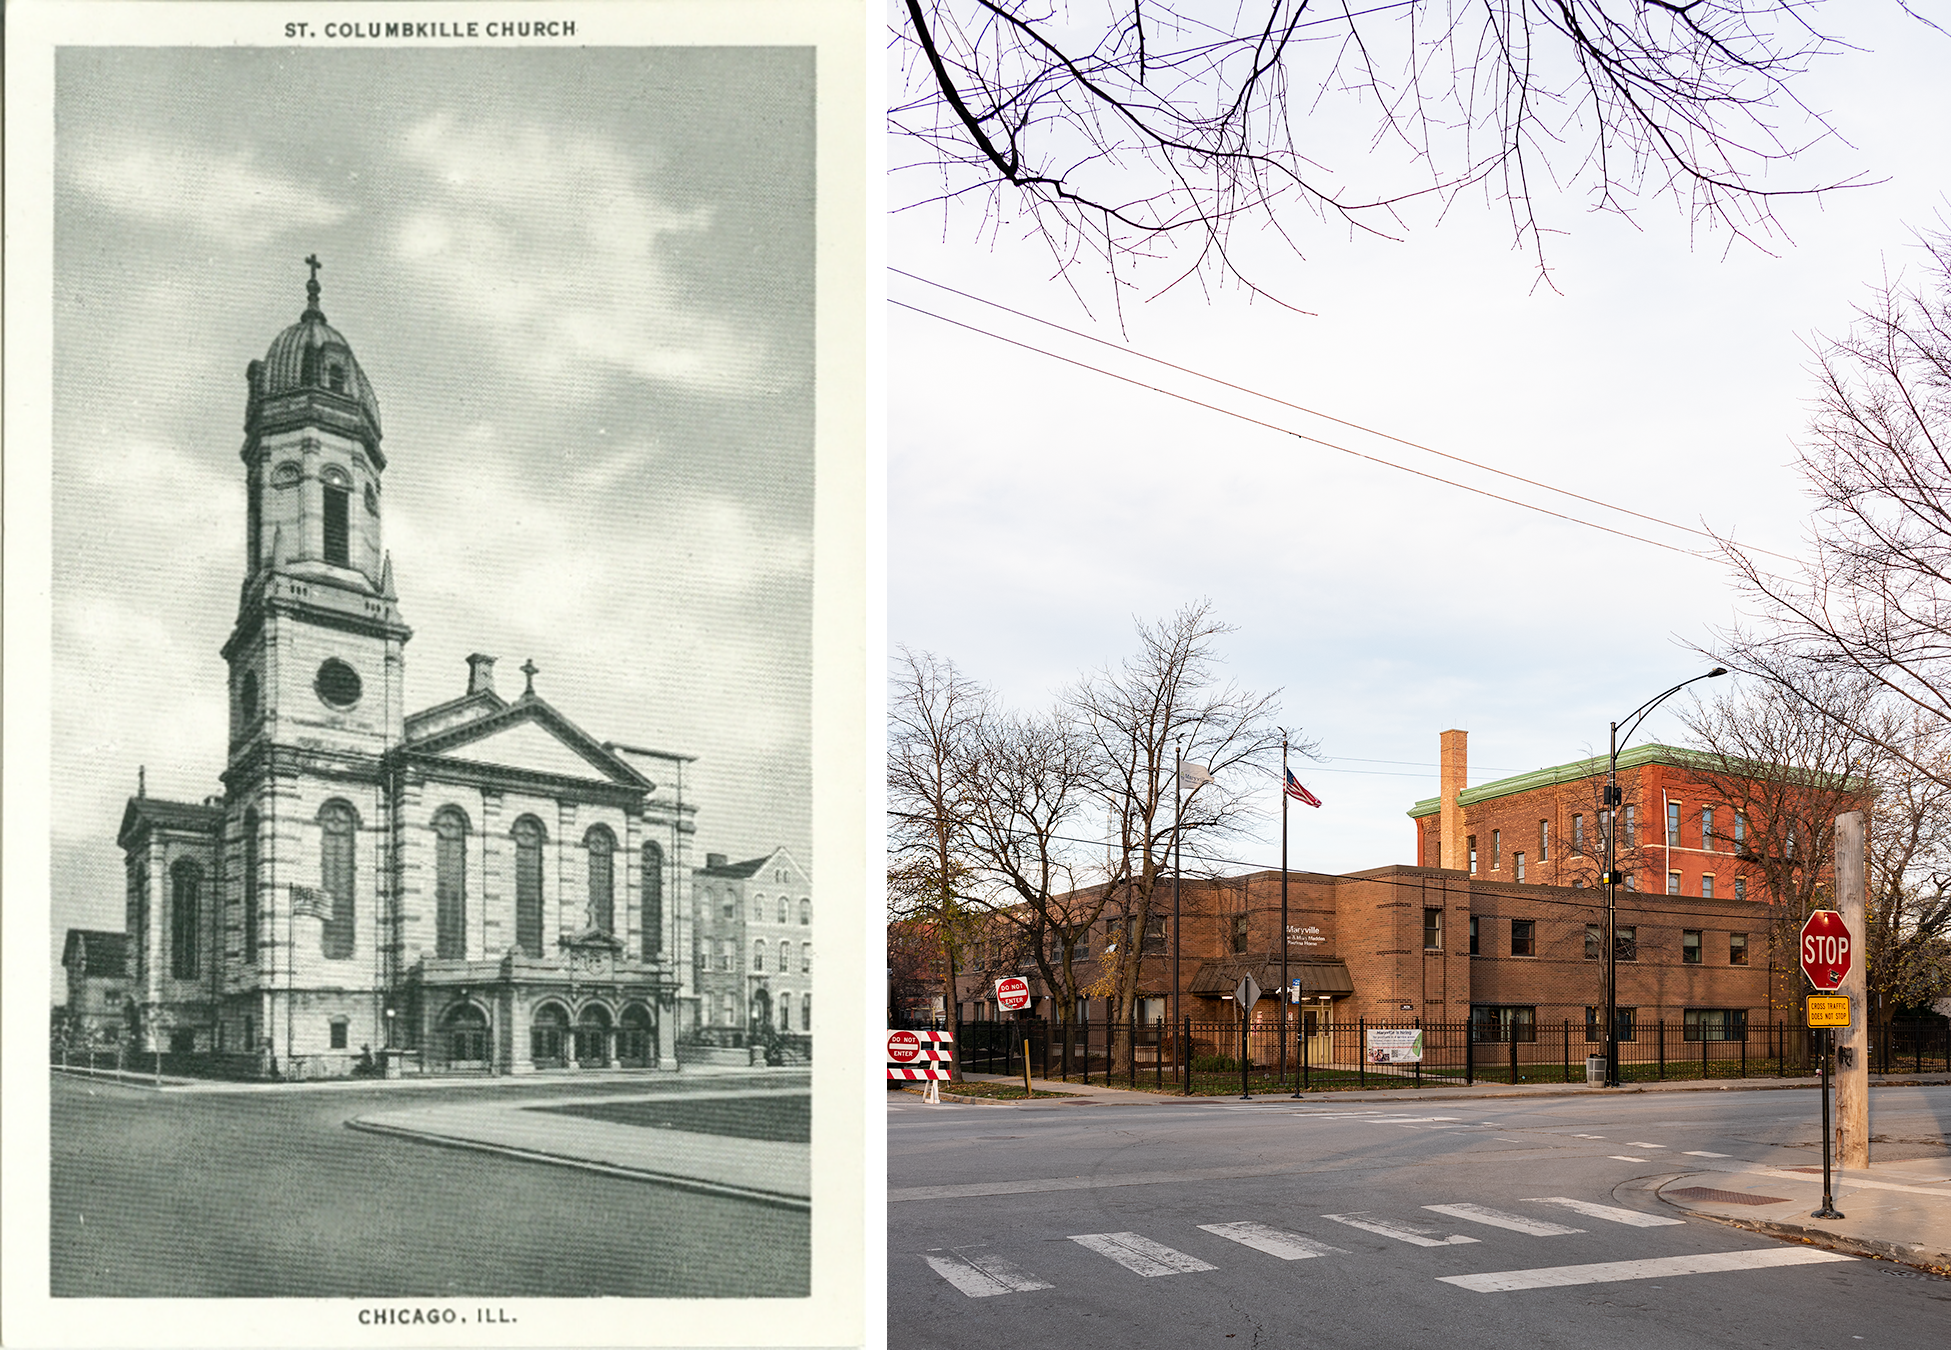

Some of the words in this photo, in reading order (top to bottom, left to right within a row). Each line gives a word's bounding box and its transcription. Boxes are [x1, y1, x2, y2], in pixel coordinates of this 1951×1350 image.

[284, 22, 316, 38] ST.
[324, 22, 479, 38] COLUMBKILLE
[486, 21, 576, 37] CHURCH
[1286, 925, 1319, 934] Maryville
[1804, 934, 1849, 965] STOP
[1811, 1012, 1823, 1020] DOES
[1825, 1012, 1833, 1020] NOT
[1835, 1012, 1847, 1020] STOP
[358, 1308, 467, 1325] CHICAGO,
[477, 1308, 518, 1324] ILL.
